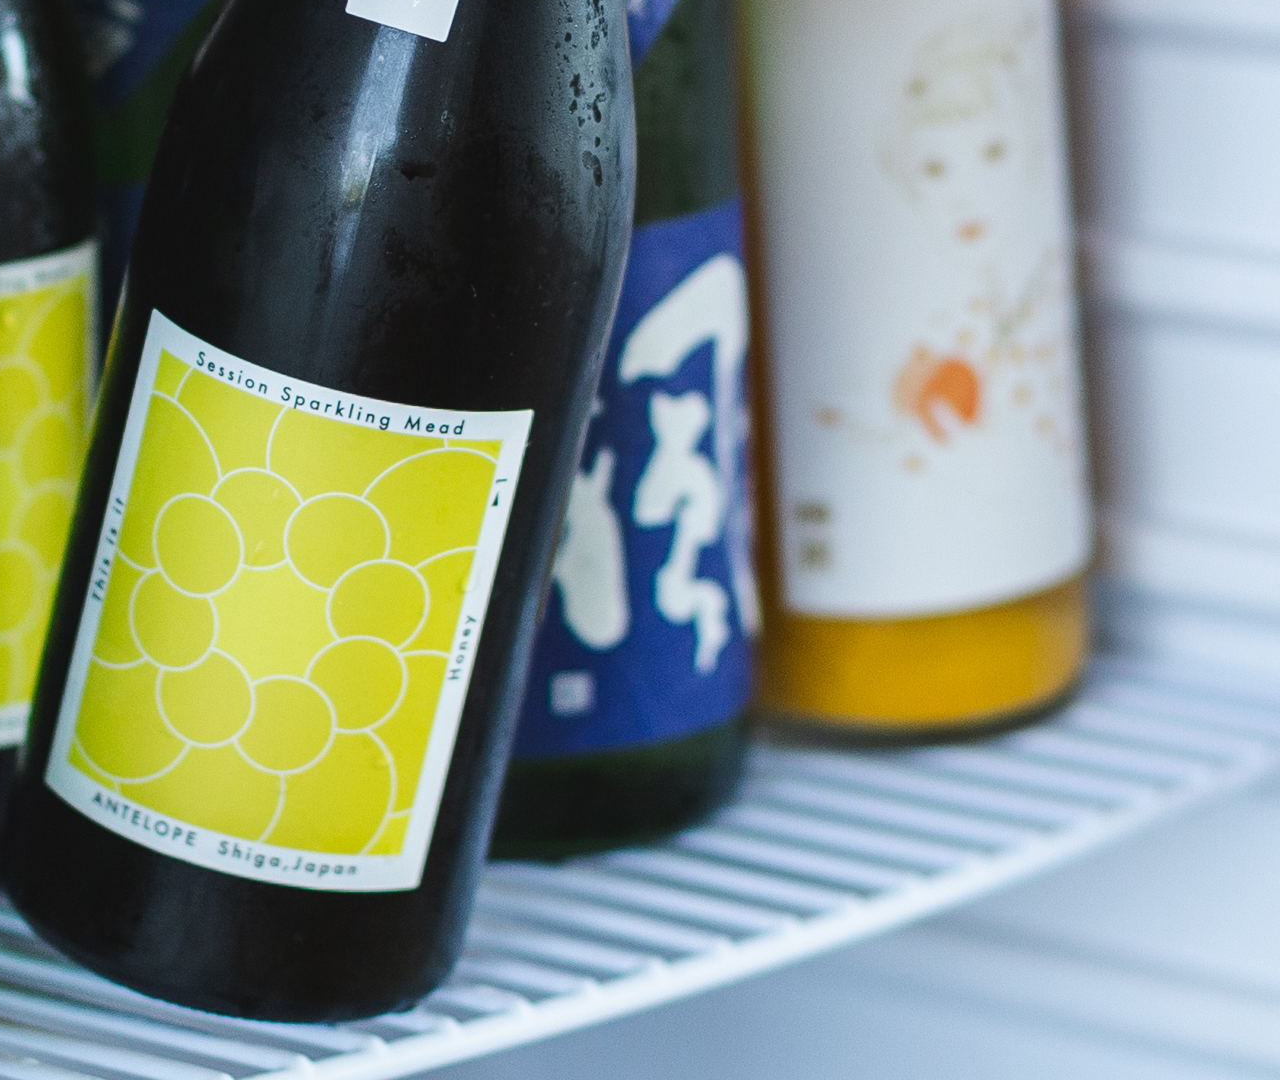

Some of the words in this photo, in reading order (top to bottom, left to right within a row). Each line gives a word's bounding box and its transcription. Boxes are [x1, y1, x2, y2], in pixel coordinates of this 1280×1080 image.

[195, 351, 268, 395] Session
[280, 386, 391, 431] Sparkling
[404, 414, 466, 436] Mead
[447, 615, 477, 680] Honey
[92, 791, 198, 847] ANTELOPE
